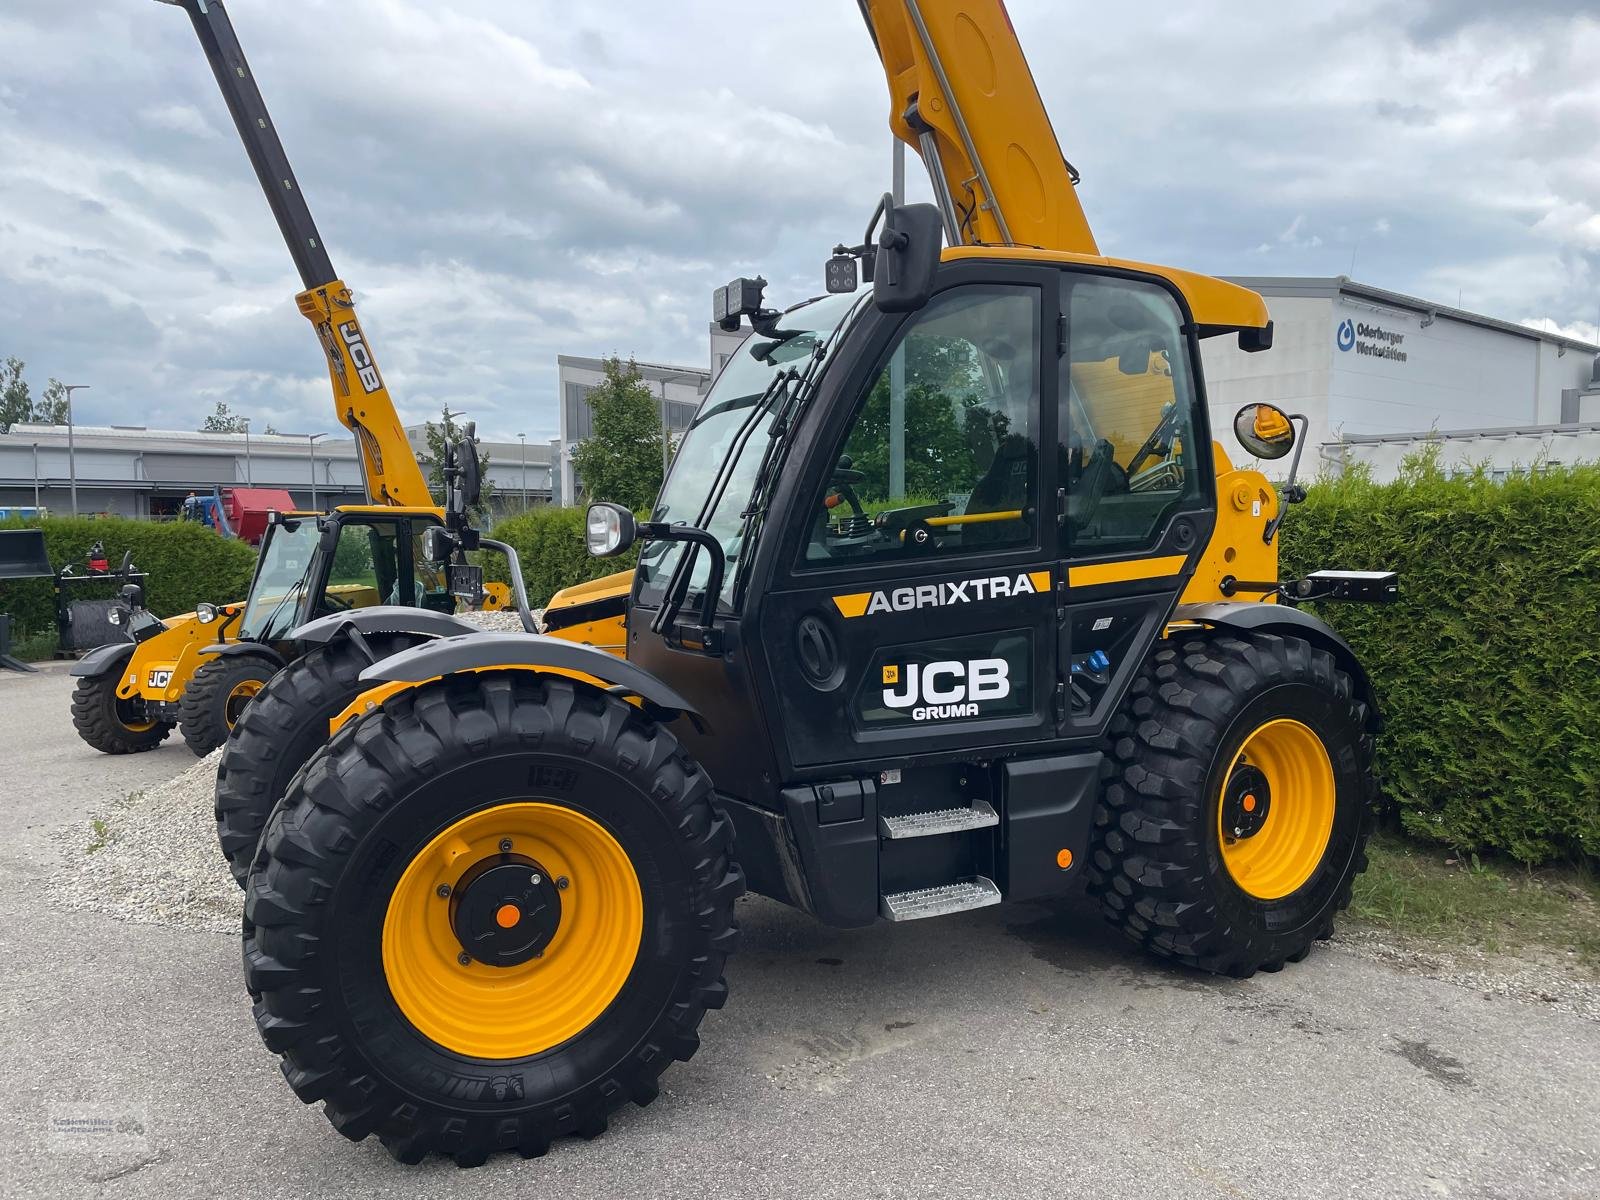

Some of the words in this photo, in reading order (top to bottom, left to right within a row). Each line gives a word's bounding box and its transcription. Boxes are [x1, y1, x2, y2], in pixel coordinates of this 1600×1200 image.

[1357, 322, 1405, 346] Oderberger
[340, 323, 381, 393] JCB
[866, 573, 1035, 615] AGRIXTRA
[882, 658, 1010, 708] JCB
[912, 703, 979, 721] GRUMA
